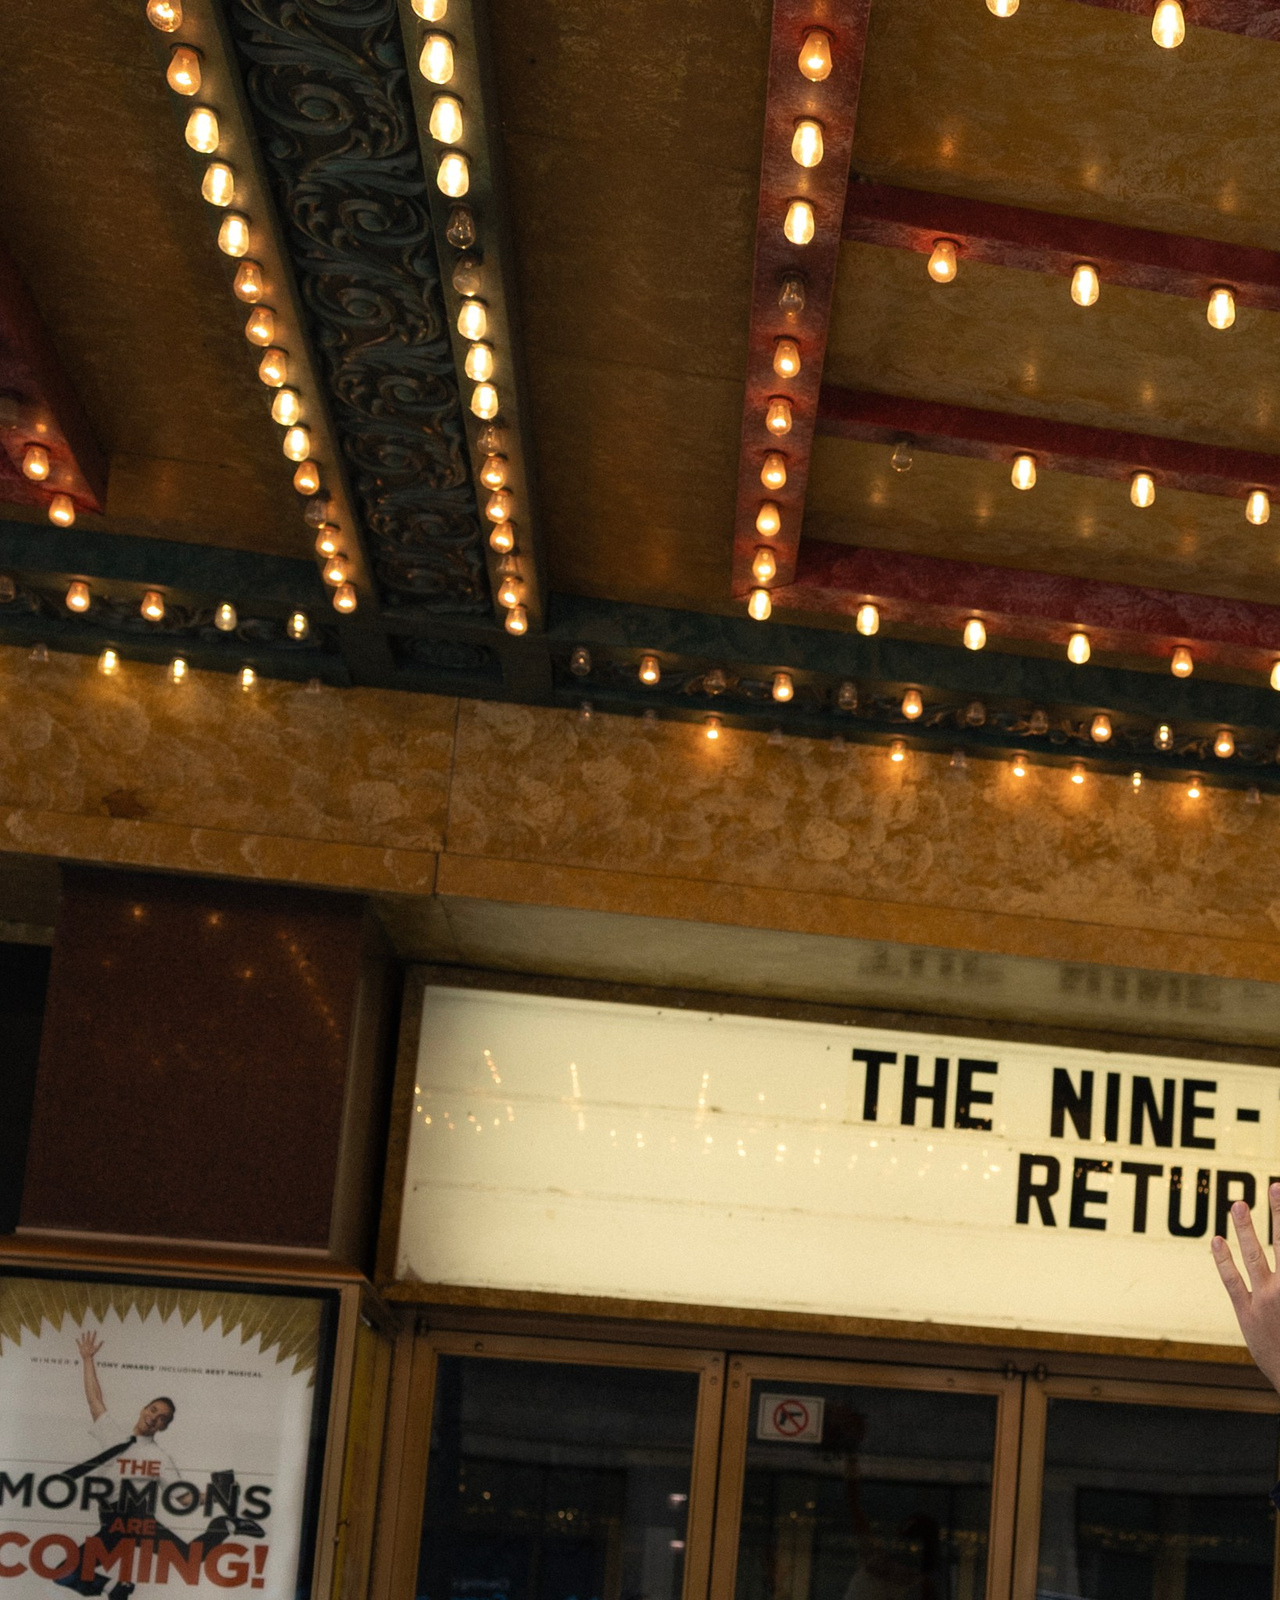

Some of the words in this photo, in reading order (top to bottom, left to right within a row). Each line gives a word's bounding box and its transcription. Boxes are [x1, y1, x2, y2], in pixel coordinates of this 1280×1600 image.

[852, 1047, 998, 1132] THE
[97, 1361, 118, 1369] TONY
[159, 1364, 203, 1374] INCLUDING
[205, 1368, 225, 1376] BEST
[228, 1370, 262, 1378] MUSICAL
[117, 1459, 161, 1476] THE
[0, 1471, 272, 1520] MORMONS
[109, 1517, 157, 1535] ARE
[0, 1531, 270, 1590] COMING!
